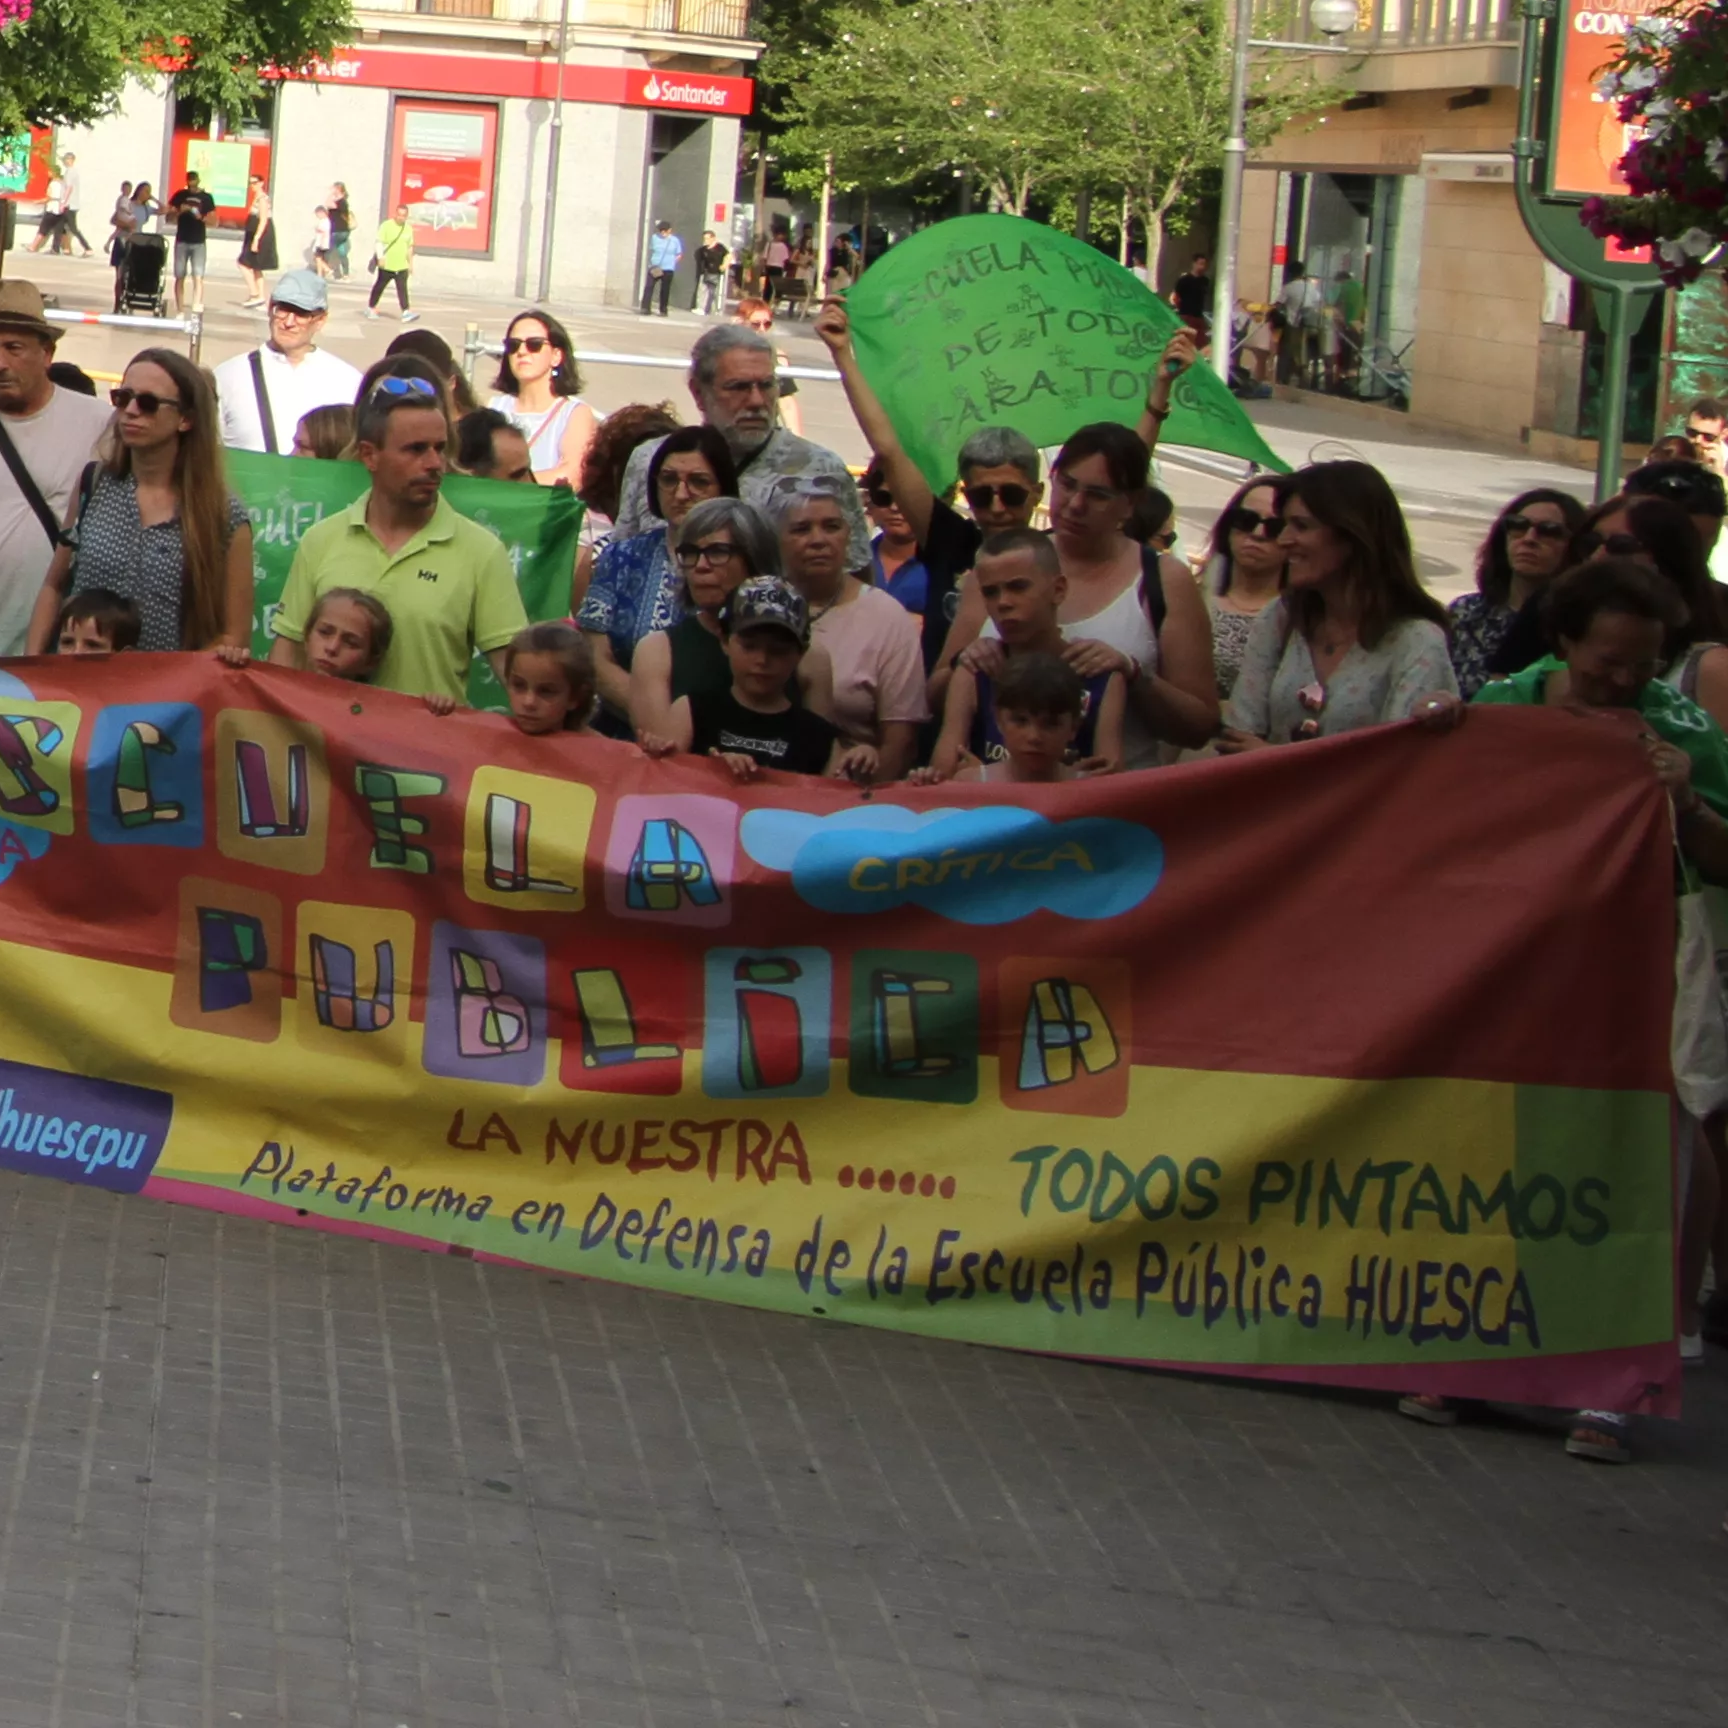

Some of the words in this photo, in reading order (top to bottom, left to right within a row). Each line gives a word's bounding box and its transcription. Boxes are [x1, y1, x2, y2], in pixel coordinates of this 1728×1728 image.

[1574, 12, 1630, 35] CON
[661, 80, 728, 106] Santander
[944, 321, 1003, 372] DE
[417, 568, 439, 583] HH
[447, 1108, 522, 1155] LA
[545, 1116, 813, 1187] NUESTRA
[1010, 1144, 1221, 1224] TODOS
[1248, 1157, 1611, 1246] PINTAMOS
[239, 1140, 493, 1223] Plataforma
[512, 1196, 566, 1242] en
[579, 1191, 769, 1278] Defensa
[795, 1214, 852, 1297] de
[867, 1224, 909, 1302] la
[924, 1228, 1113, 1316] Escuela
[1134, 1239, 1324, 1332] Pública
[1344, 1253, 1542, 1350] HUESCA
